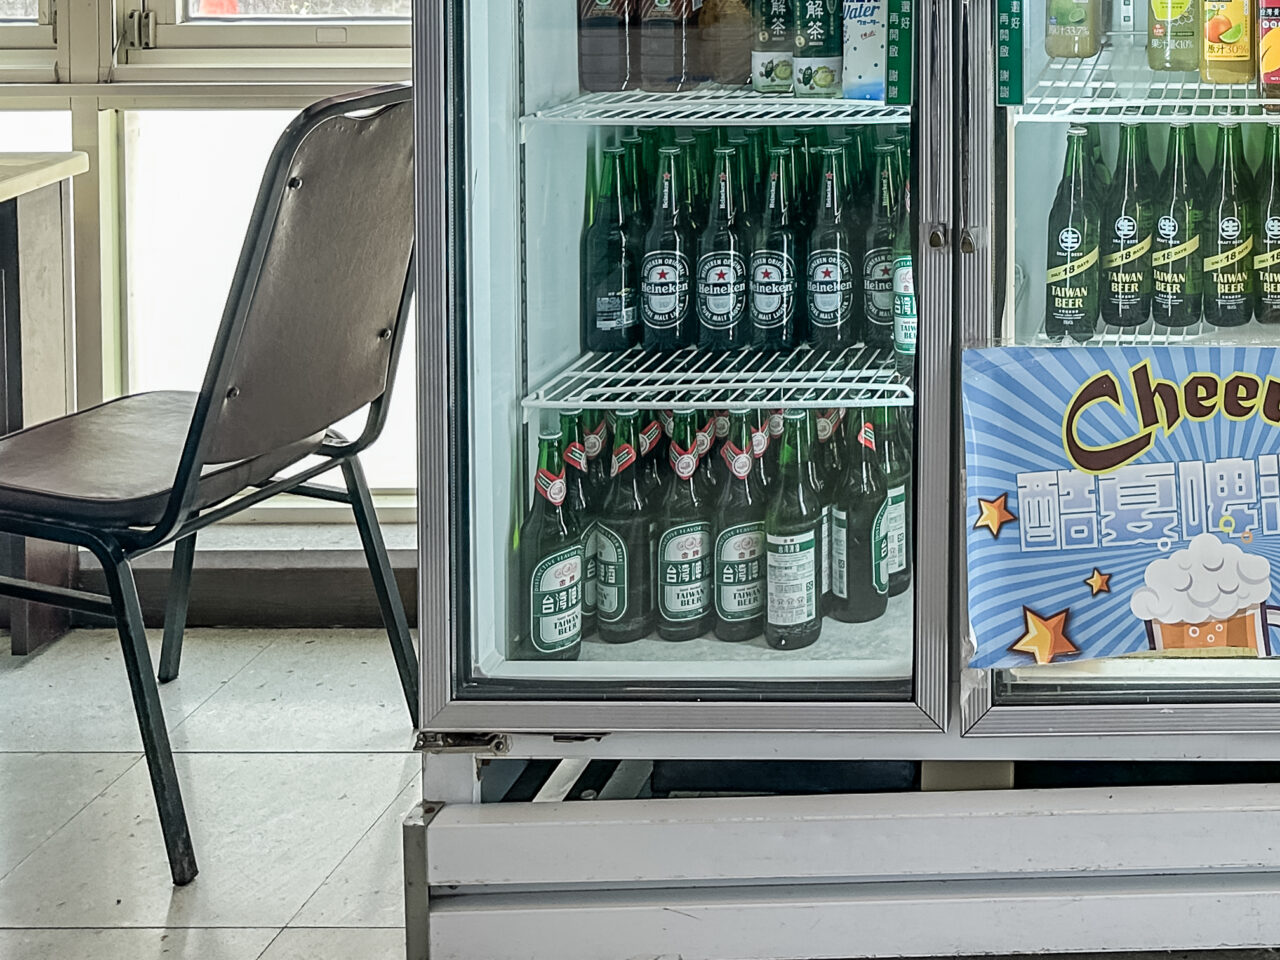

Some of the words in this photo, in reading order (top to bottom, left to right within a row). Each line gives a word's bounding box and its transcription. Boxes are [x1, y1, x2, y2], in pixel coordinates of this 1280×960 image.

[1118, 251, 1132, 262] 18
[1161, 251, 1173, 261] 18
[1224, 251, 1238, 262] 18
[1062, 263, 1076, 275] 18
[1108, 270, 1144, 283] TAIWAN
[1153, 269, 1187, 284] TAIWAN
[1211, 271, 1249, 283] TAIWAN
[641, 281, 689, 294] Heineken
[698, 281, 746, 295] Heineken
[807, 280, 853, 292] Heineken
[863, 279, 893, 291] Heine
[1111, 282, 1139, 293] BEER
[1155, 282, 1182, 294] BEER
[1217, 282, 1246, 293] BEER
[1050, 285, 1088, 298] TAIWAN
[1054, 297, 1084, 309] BEER
